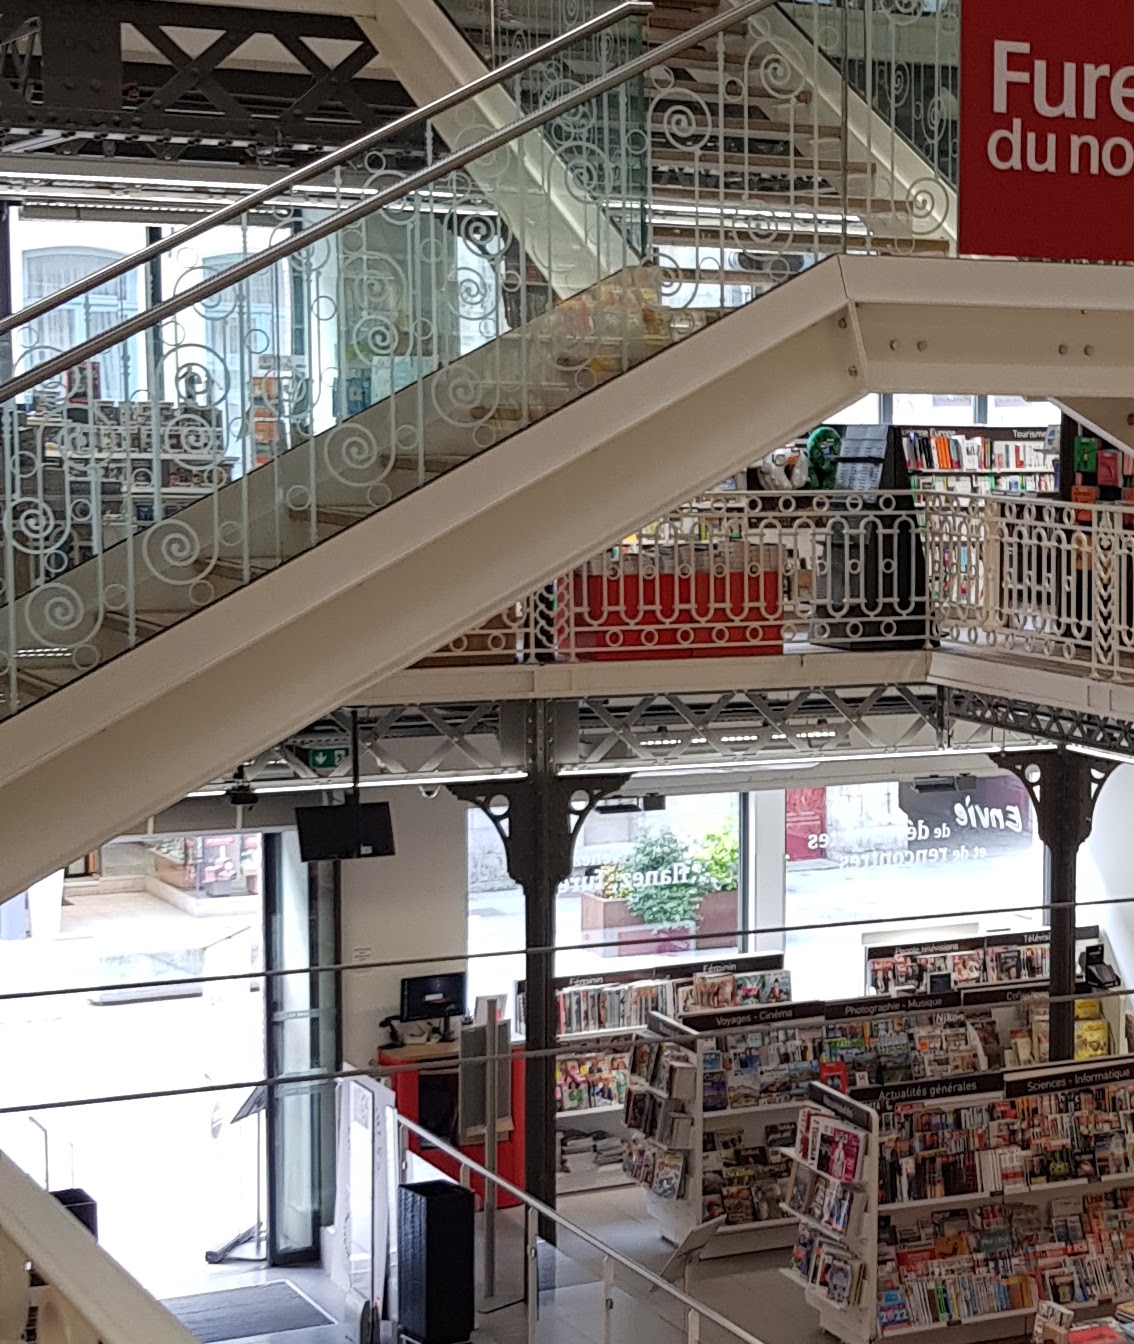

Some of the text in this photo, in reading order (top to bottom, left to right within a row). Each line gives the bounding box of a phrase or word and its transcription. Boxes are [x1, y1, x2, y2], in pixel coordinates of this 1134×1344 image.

[987, 117, 1056, 173] du
[702, 963, 737, 973] Féminin
[716, 1015, 752, 1029] Voyages
[760, 1010, 793, 1023] Cinéma
[1027, 1077, 1066, 1092] Sciences
[1075, 1067, 1131, 1086] Informatique
[878, 1080, 977, 1100] Actualités générales
